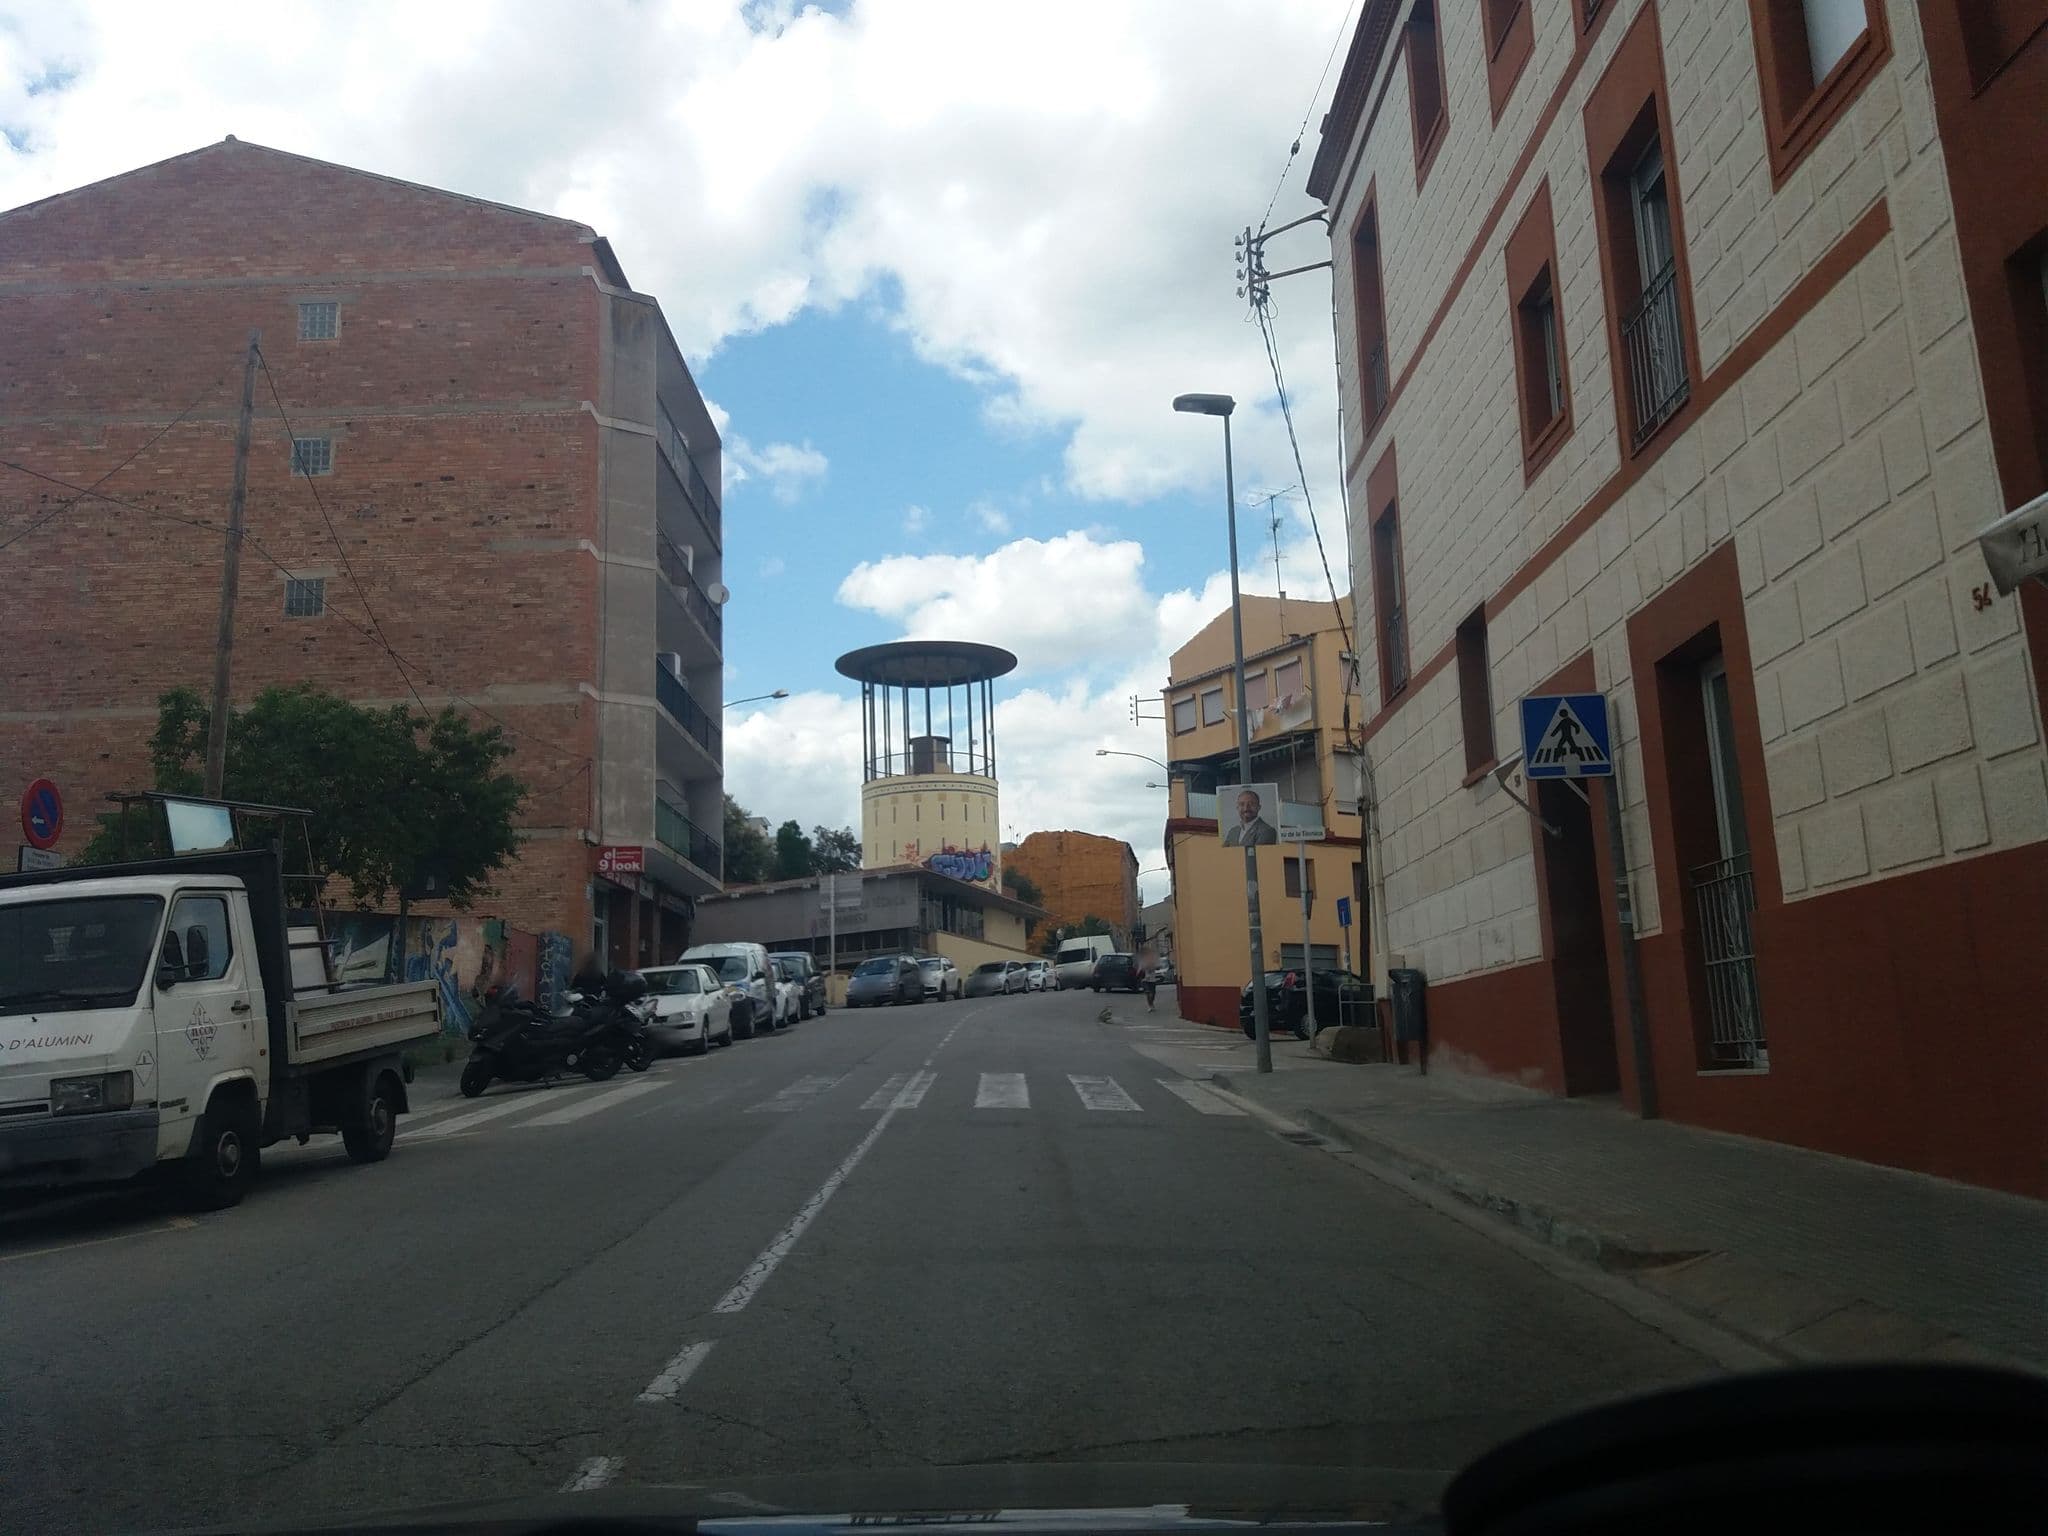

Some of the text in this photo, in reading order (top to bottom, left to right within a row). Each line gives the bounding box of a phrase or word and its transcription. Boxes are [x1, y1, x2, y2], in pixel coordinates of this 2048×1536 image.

[603, 848, 616, 860] el
[599, 859, 640, 871] 9 look
[9, 1033, 94, 1050] D'ALUMINI
